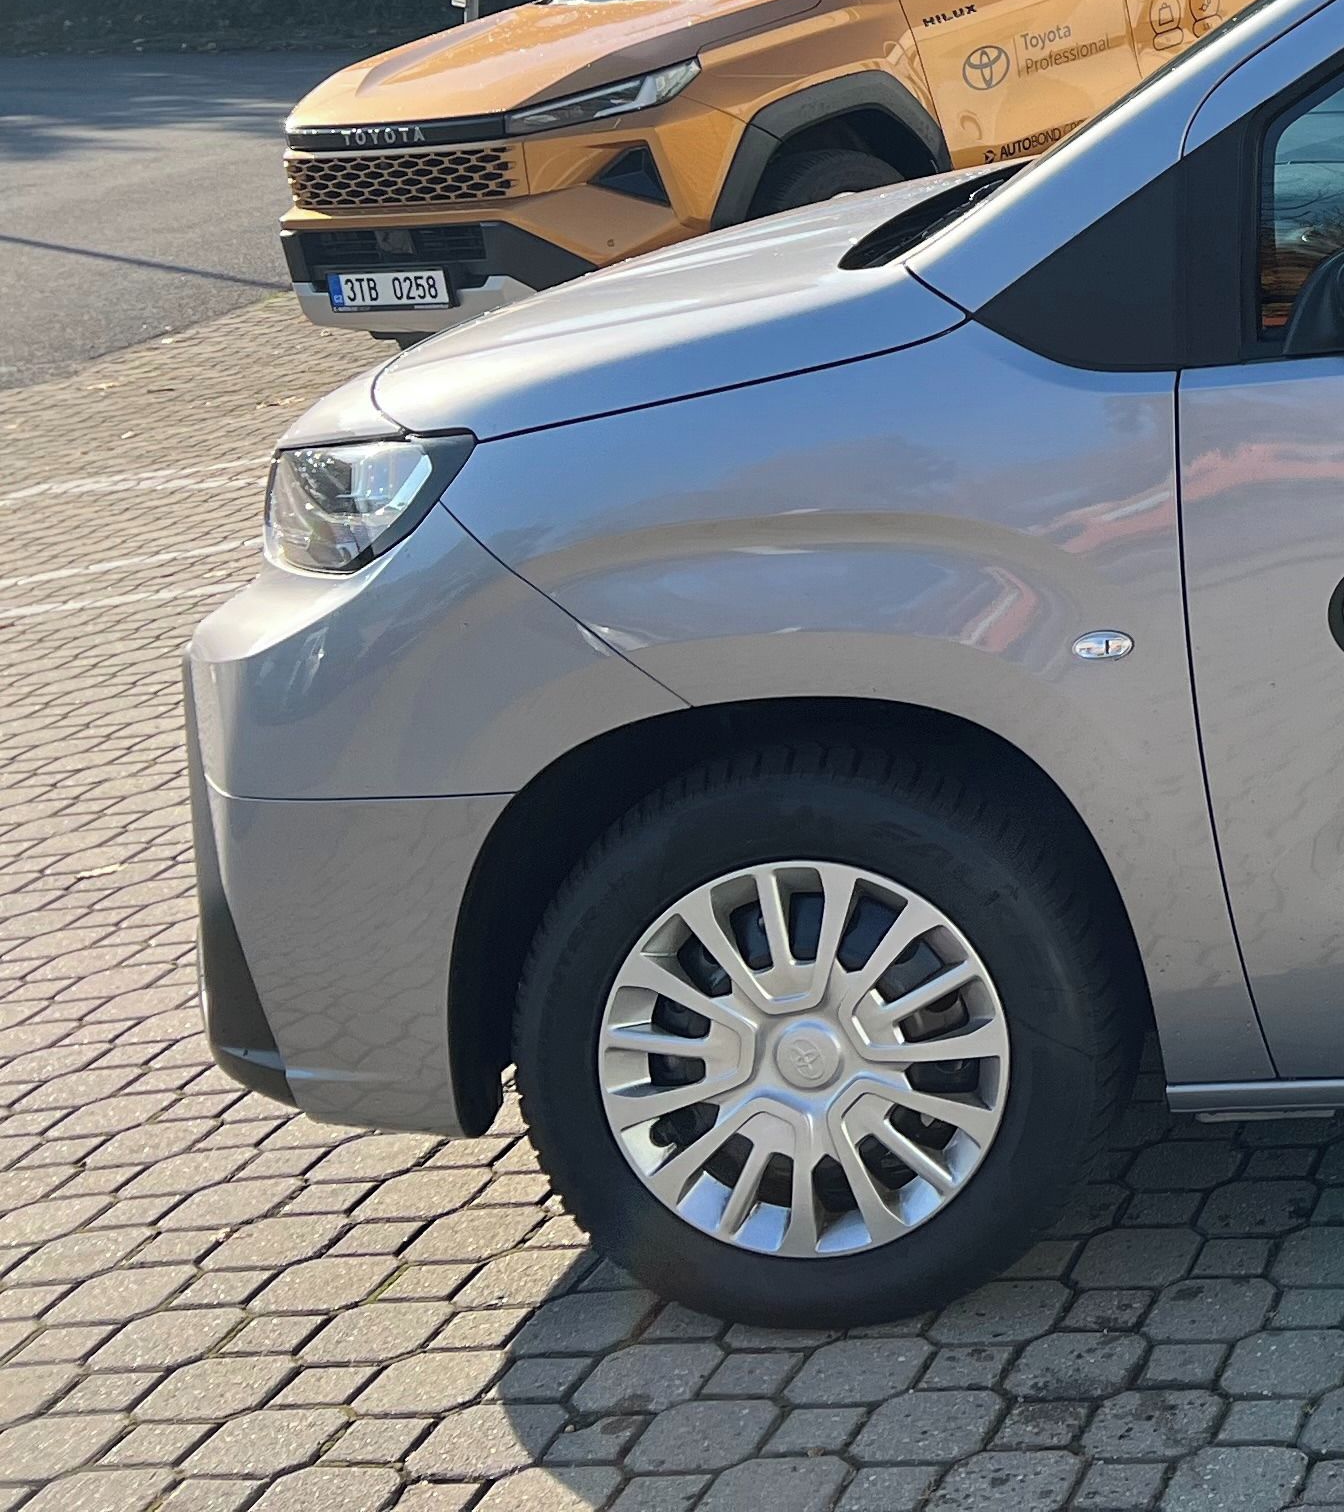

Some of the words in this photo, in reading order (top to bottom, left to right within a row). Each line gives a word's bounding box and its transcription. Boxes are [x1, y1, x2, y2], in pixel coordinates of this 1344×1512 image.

[922, 3, 977, 28] HILUX
[1020, 23, 1072, 51] Toyota
[1025, 37, 1111, 75] Professional
[341, 126, 425, 146] TOYOTA
[1000, 127, 1061, 160] AUTOBOND
[344, 277, 379, 302] 3TB
[392, 275, 439, 300] 0258
